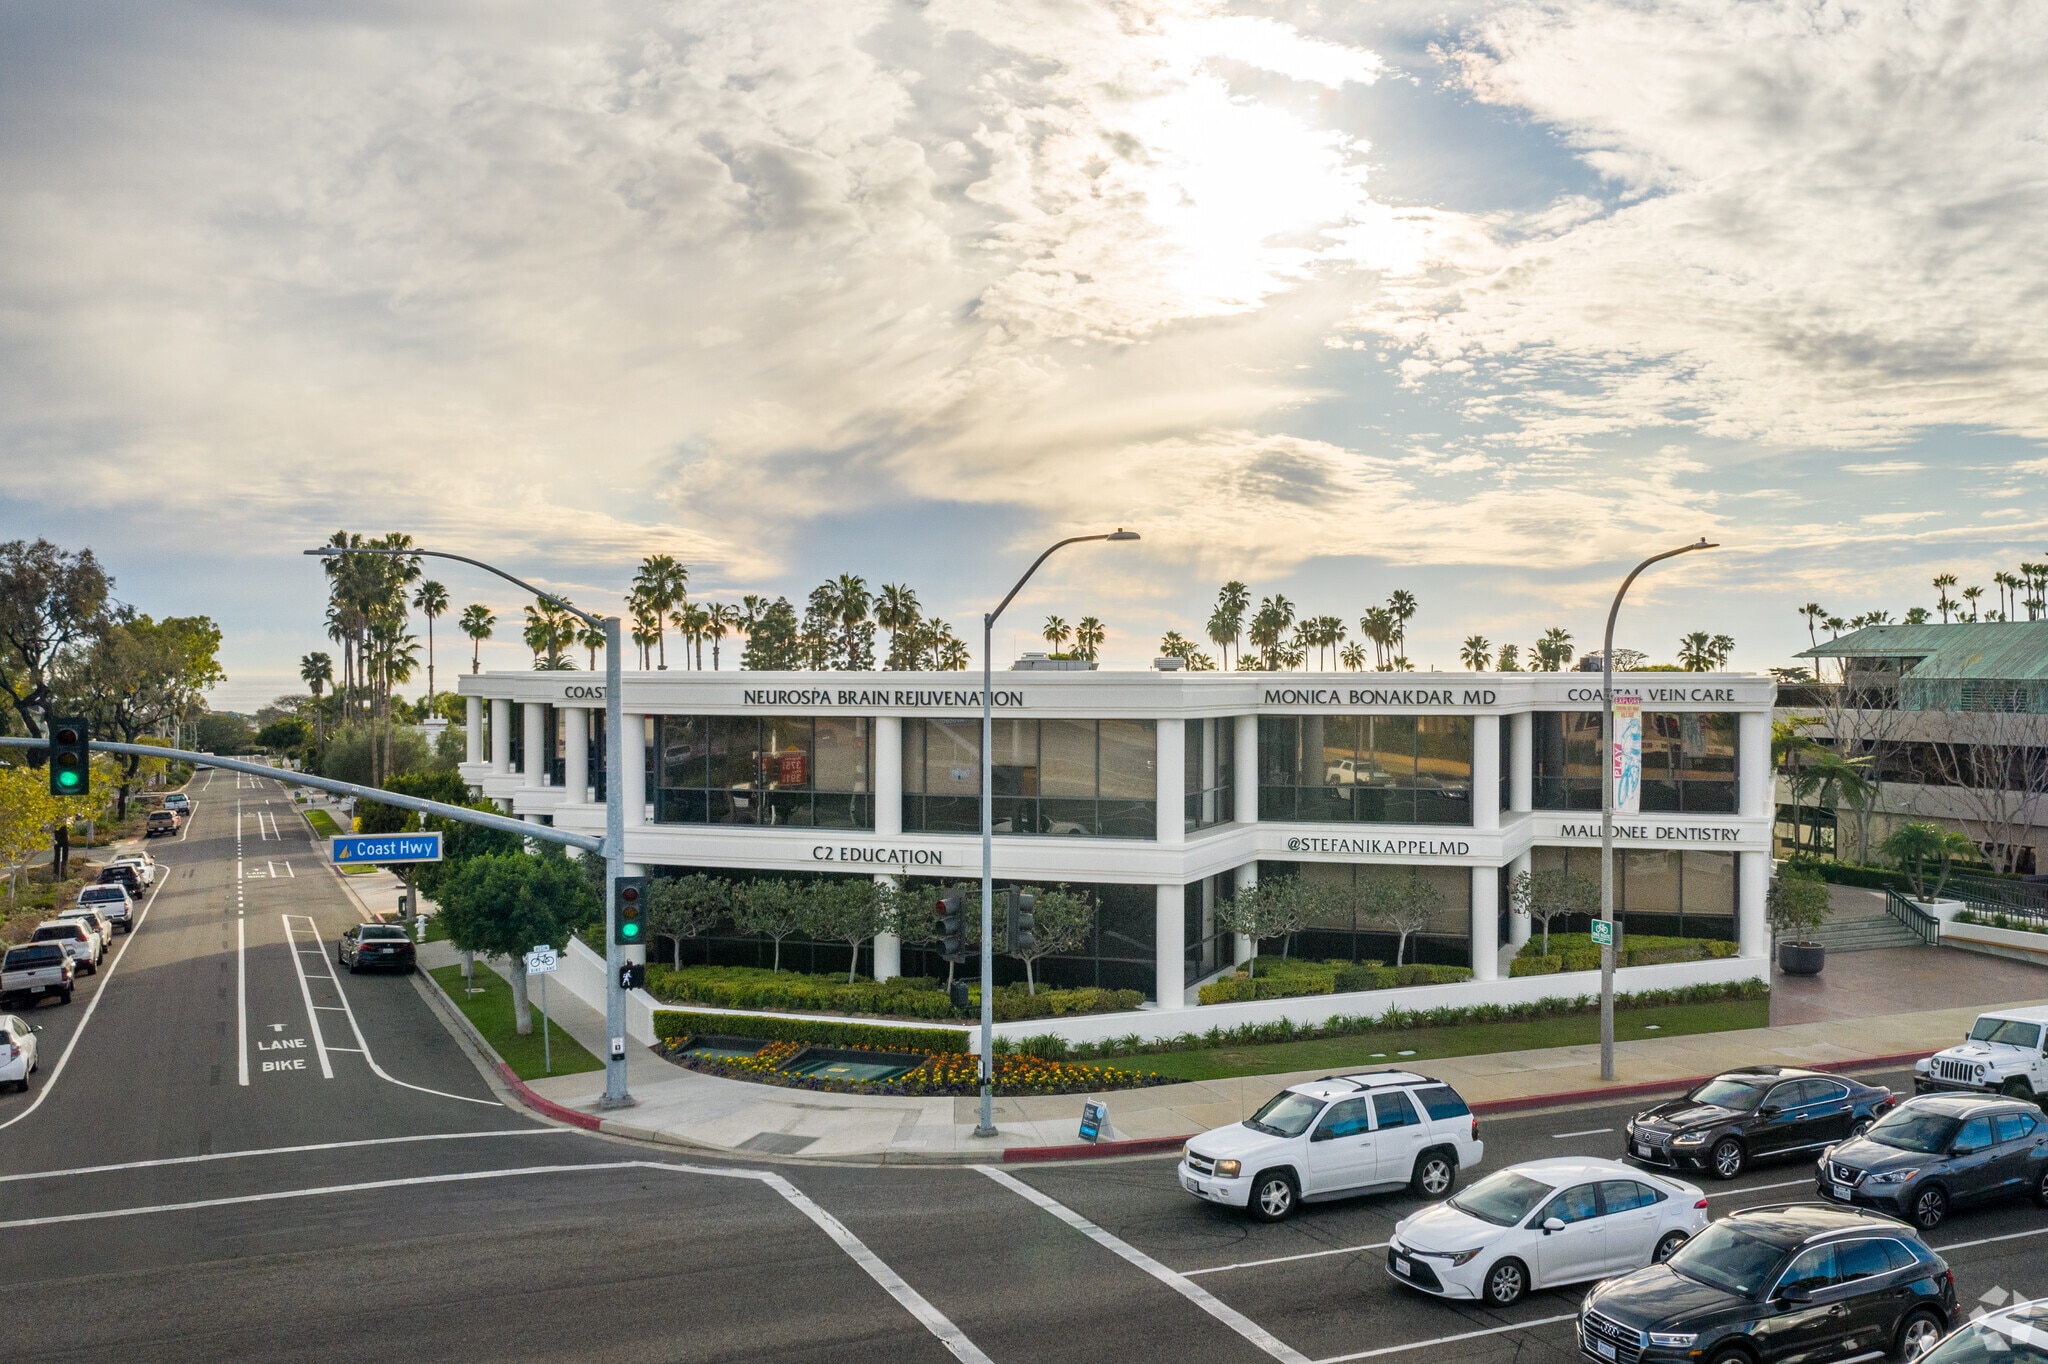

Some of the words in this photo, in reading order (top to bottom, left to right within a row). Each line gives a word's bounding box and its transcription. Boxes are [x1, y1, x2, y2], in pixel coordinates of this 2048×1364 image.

[743, 690, 832, 705] NEUROSPA
[838, 690, 889, 705] BRAIN
[894, 691, 1023, 707] REJUVENATION
[1264, 689, 1342, 704] MONICA
[1349, 690, 1455, 705] BONAKDAR
[1463, 690, 1496, 705] MD
[1648, 688, 1686, 701] VEIN
[1691, 688, 1735, 701] CARE
[1614, 748, 1622, 777] PLAY
[1561, 824, 1648, 839] MALLONEE
[1656, 827, 1740, 841] DENTISTRY
[357, 842, 396, 856] Coast
[400, 840, 433, 857] Hwy
[1287, 836, 1469, 855] @STEFANIKAPPELMD
[813, 846, 834, 860] C2
[840, 847, 942, 865] EDUCATION
[257, 1038, 307, 1050] LANE
[262, 1059, 307, 1072] BIKE
